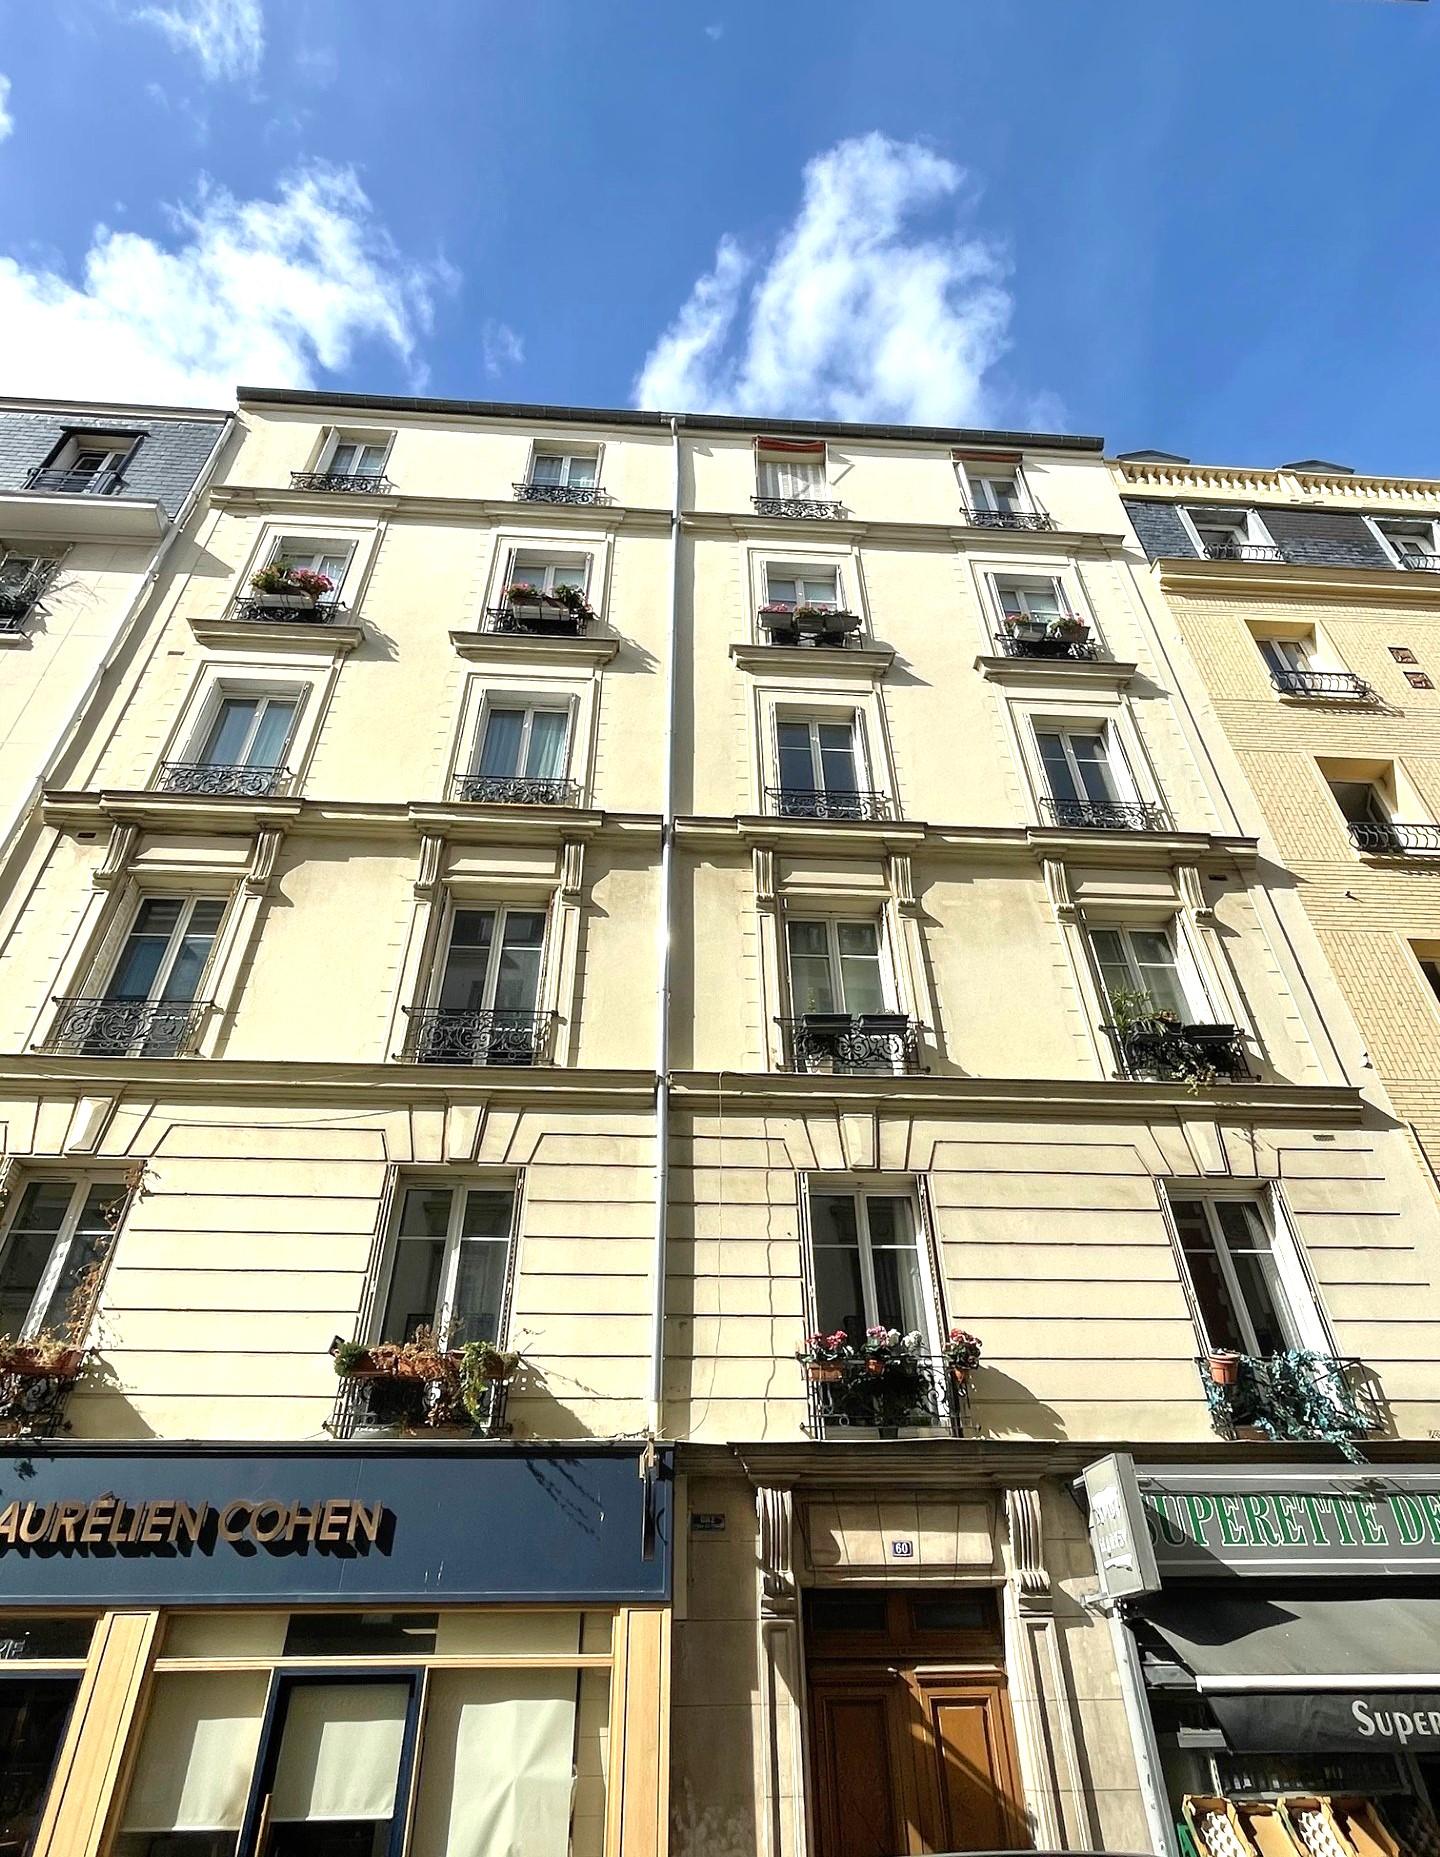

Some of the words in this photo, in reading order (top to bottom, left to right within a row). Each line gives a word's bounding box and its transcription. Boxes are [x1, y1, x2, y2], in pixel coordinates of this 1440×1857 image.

[0, 1491, 206, 1543] AURÉLIEN
[217, 1499, 382, 1543] COHEN
[895, 1542, 909, 1554] 60
